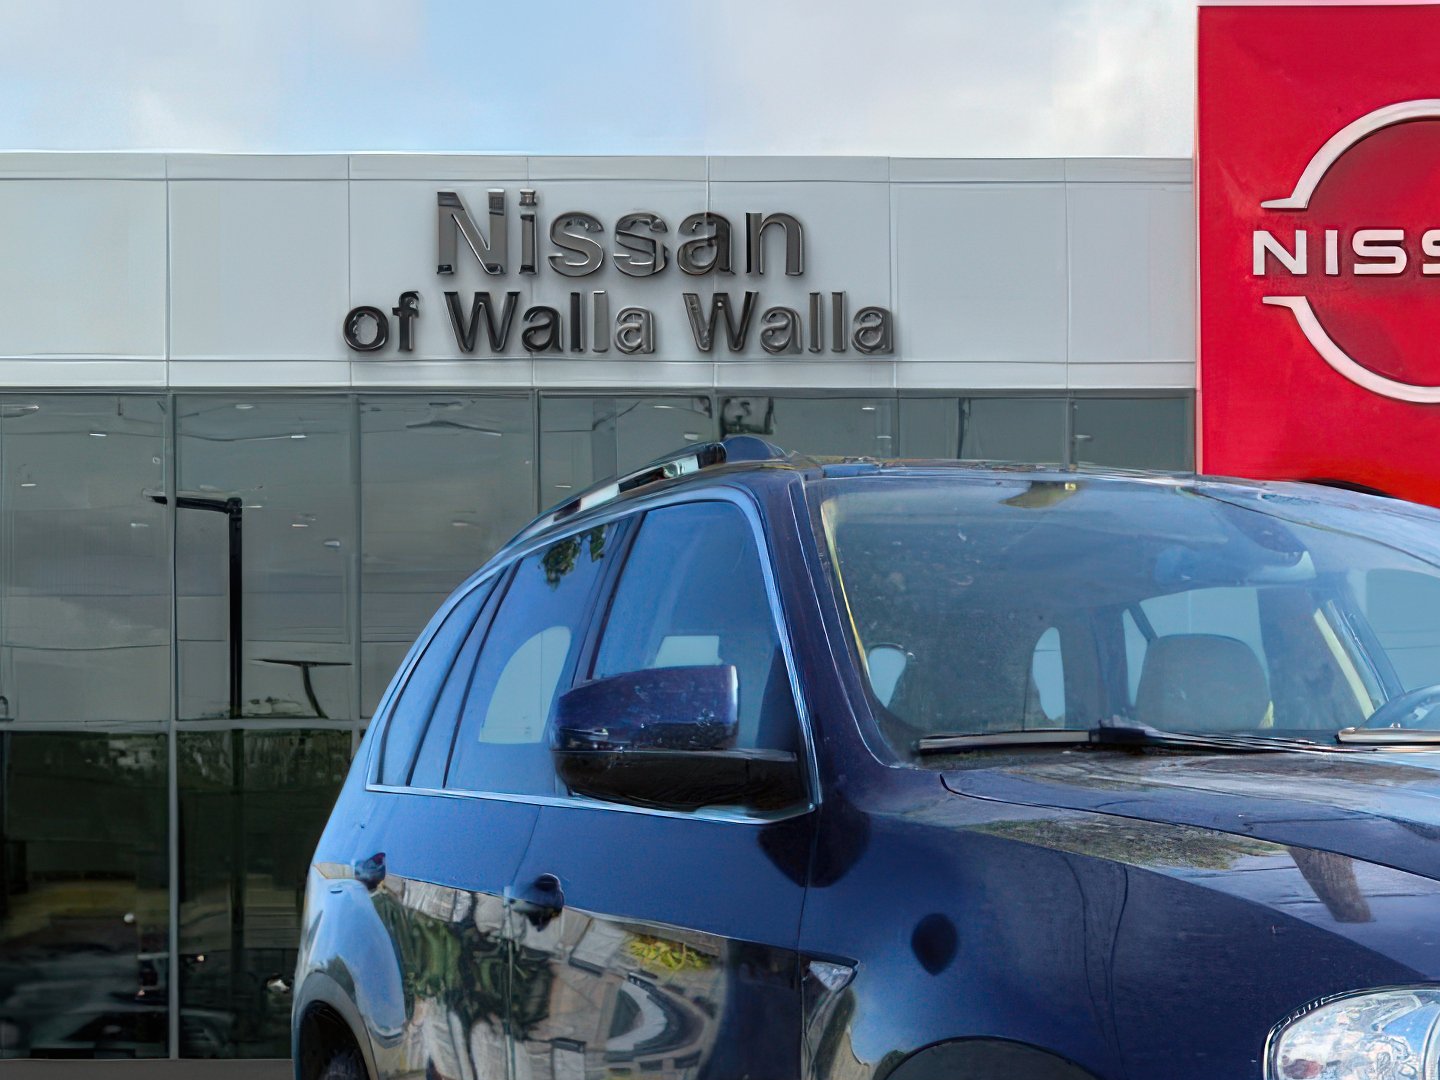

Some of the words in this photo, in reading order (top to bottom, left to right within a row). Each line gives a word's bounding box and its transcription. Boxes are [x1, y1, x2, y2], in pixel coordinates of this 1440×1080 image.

[436, 188, 804, 277] Nissan
[343, 290, 420, 352] of
[445, 291, 656, 354] Walla
[683, 290, 895, 354] Walla
